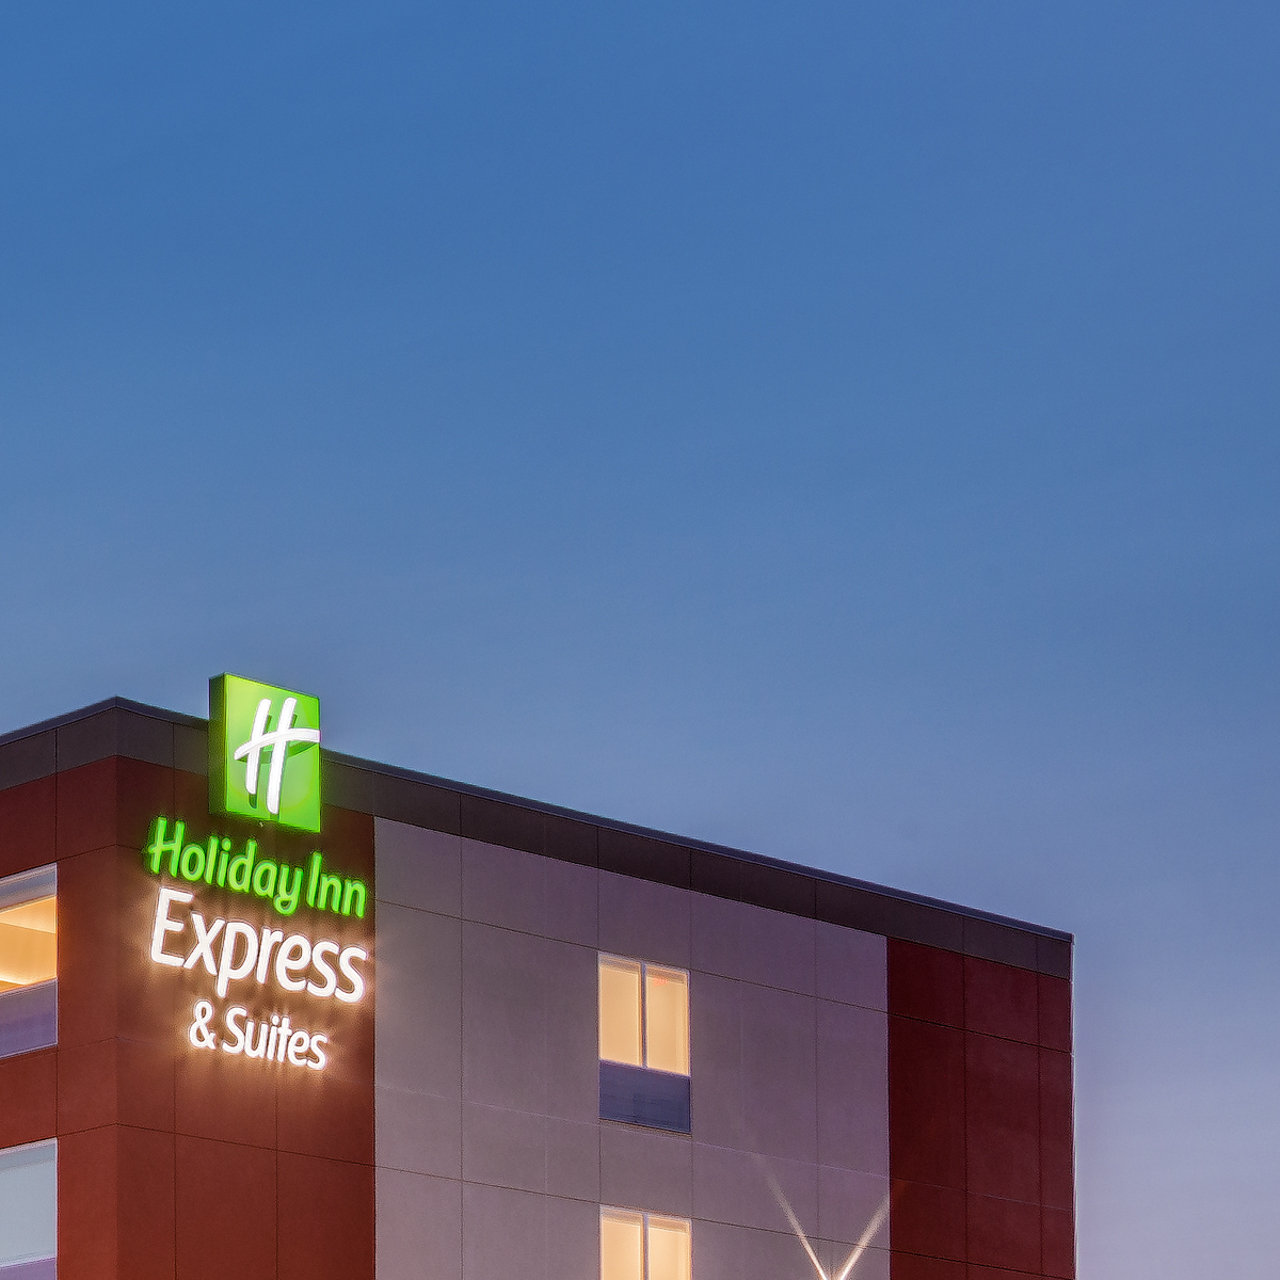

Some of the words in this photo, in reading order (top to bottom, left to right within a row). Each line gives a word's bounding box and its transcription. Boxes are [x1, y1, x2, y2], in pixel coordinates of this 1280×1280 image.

[147, 816, 303, 916] Holiday
[307, 852, 367, 919] Inn
[150, 887, 369, 1003] Express
[188, 1000, 216, 1050] &
[222, 1006, 329, 1071] Suites
